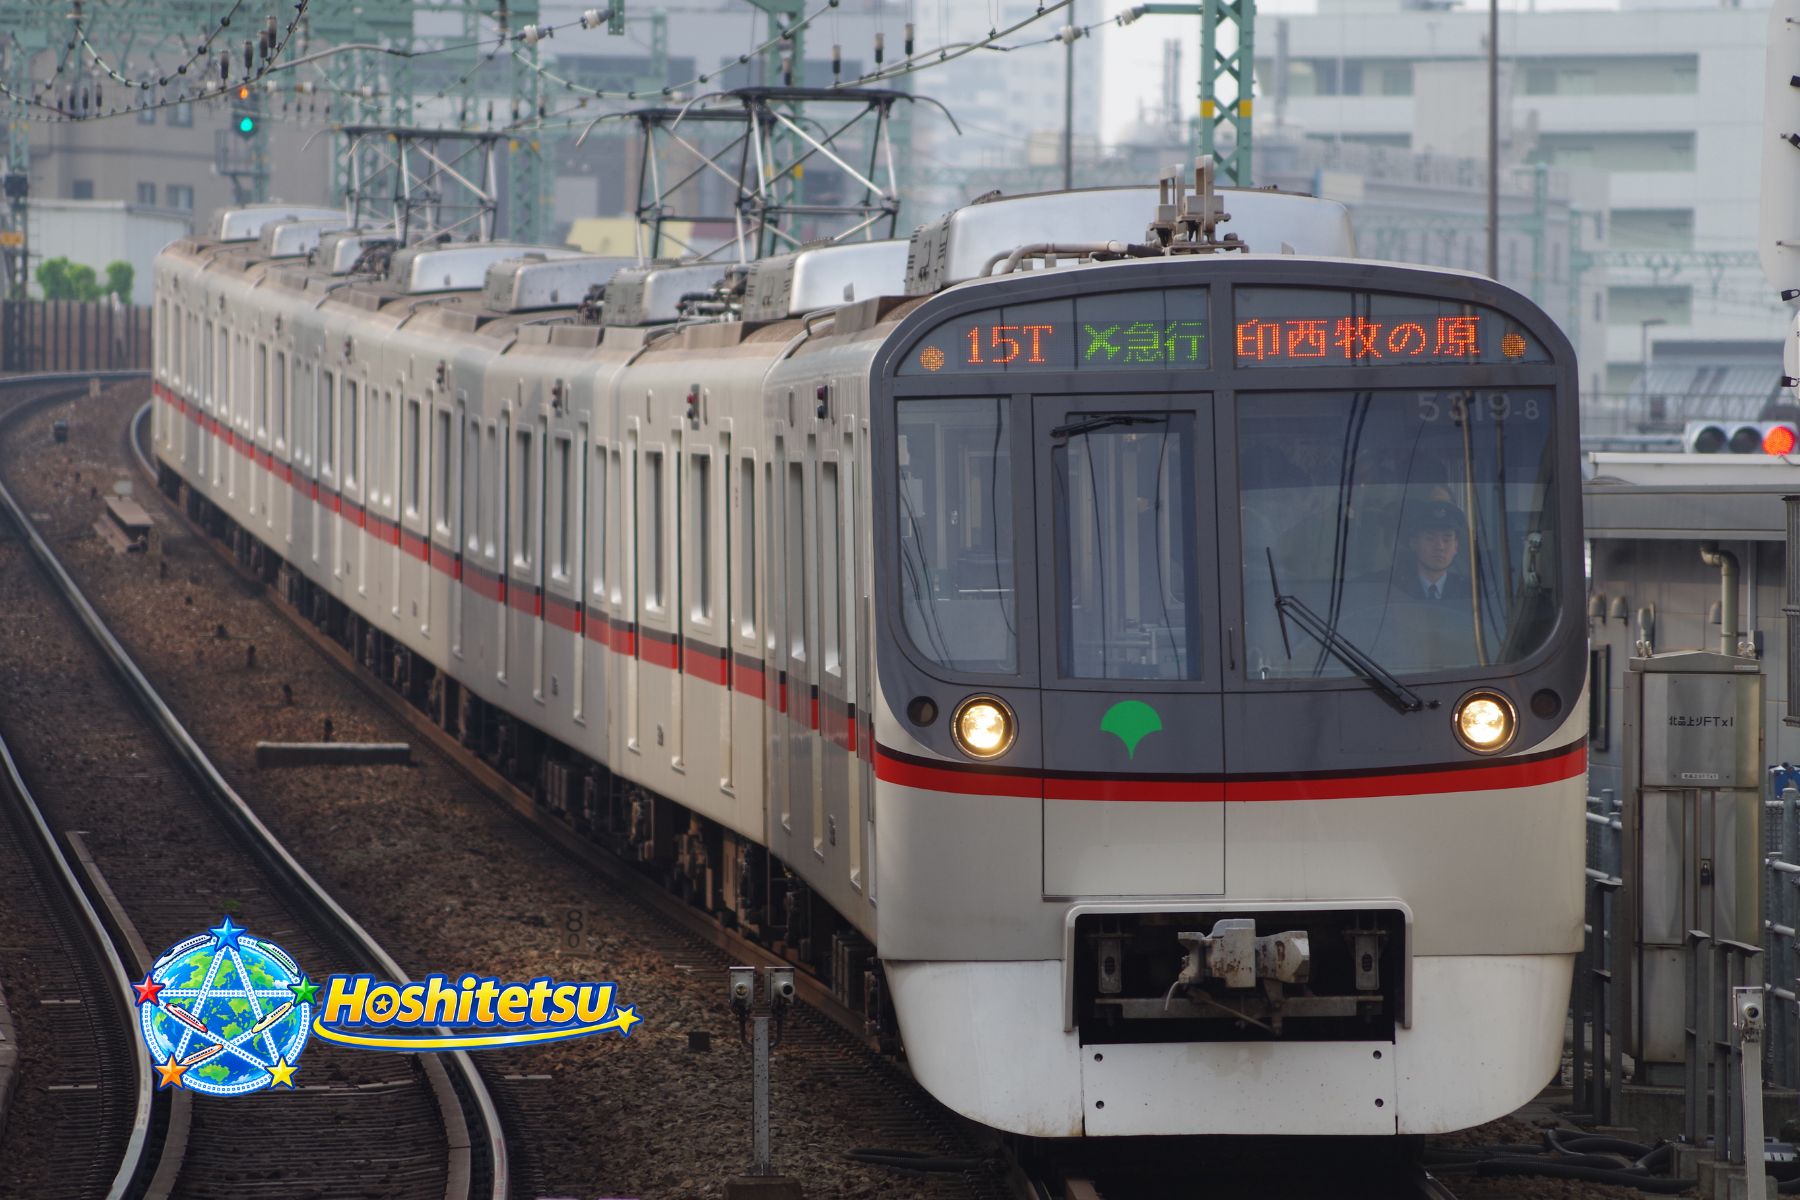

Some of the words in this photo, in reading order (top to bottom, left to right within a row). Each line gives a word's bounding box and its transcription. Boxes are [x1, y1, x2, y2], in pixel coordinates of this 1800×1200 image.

[967, 324, 1053, 363] 15T
[1236, 316, 1480, 360] 印西牧の原
